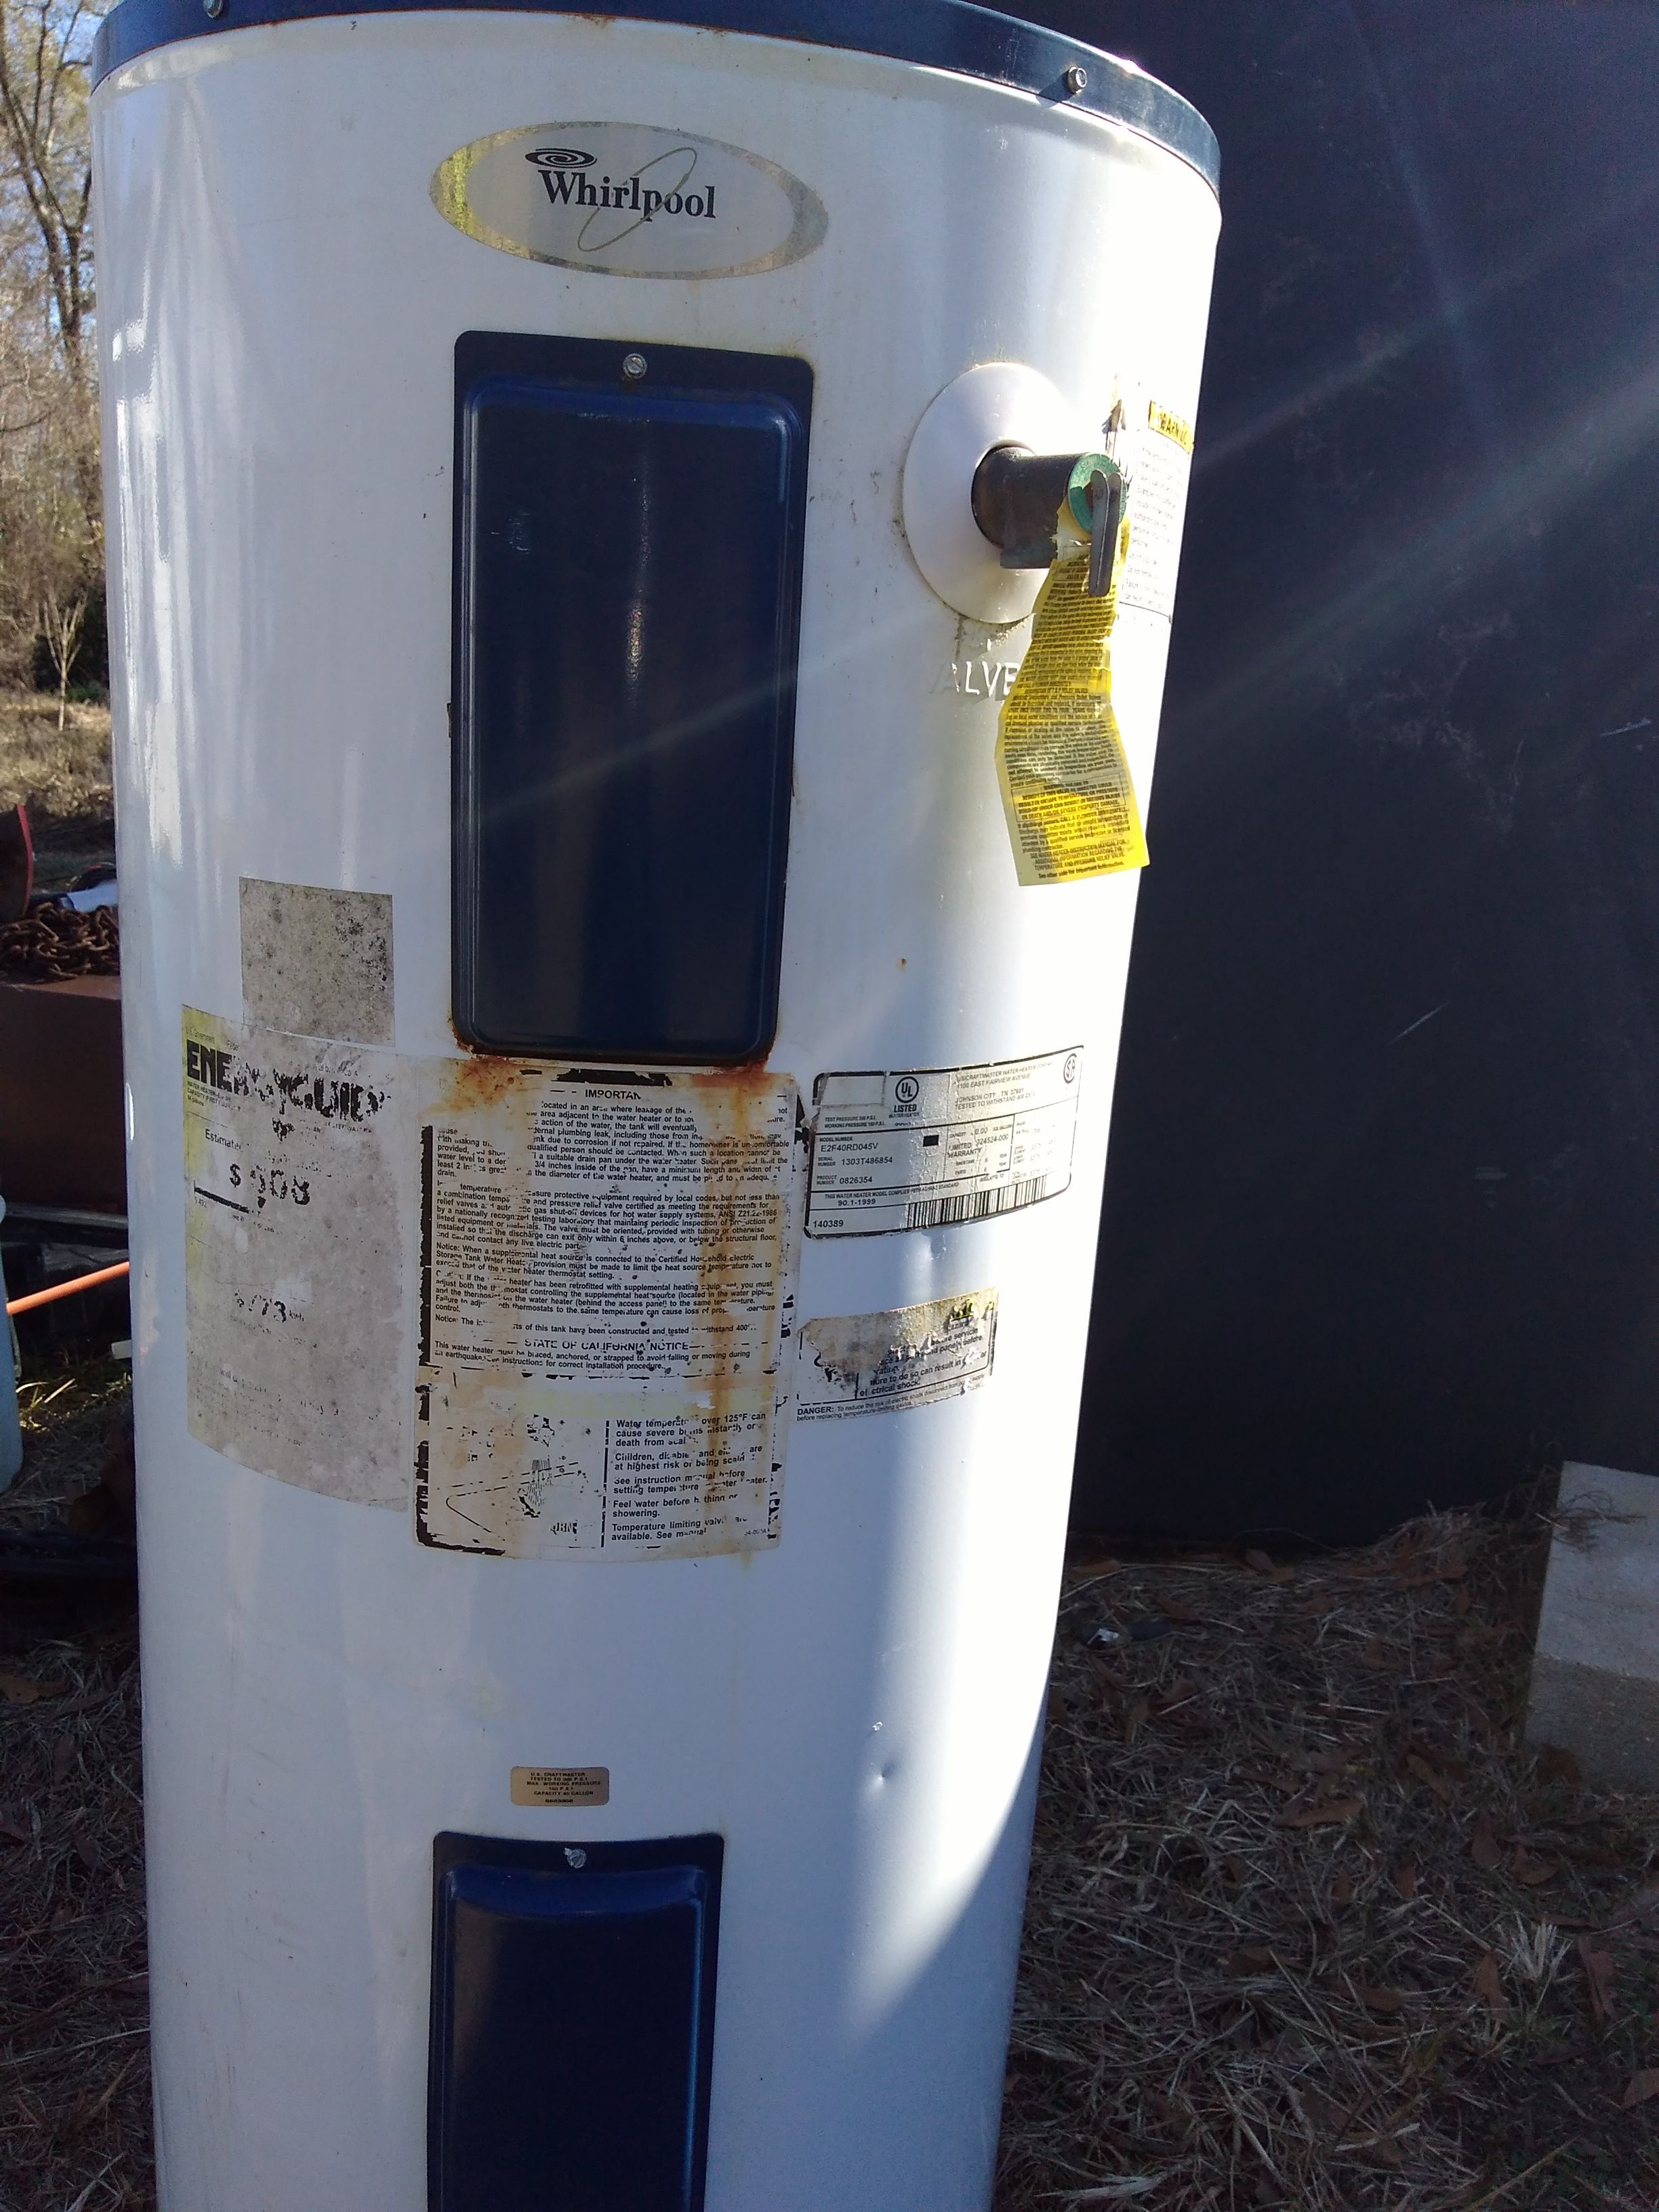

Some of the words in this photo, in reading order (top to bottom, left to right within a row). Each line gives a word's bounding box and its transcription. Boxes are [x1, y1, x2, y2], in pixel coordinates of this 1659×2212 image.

[537, 169, 716, 222] Whirlpool
[1012, 1073, 1030, 1081] AVENUE
[586, 1089, 641, 1099] IMPORTAN
[956, 1094, 982, 1103] JOHNSON
[894, 1104, 917, 1113] LISTED
[956, 1101, 976, 1110] TESTED
[559, 1111, 589, 1121] adjacent
[614, 1131, 647, 1141] including
[574, 1138, 608, 1146] corrosion
[560, 1147, 585, 1156] person
[821, 1143, 878, 1152] E2F40RD045V
[948, 1147, 982, 1158] WARRANTY
[577, 1155, 595, 1163] drain
[842, 1157, 893, 1165] 1303T486854
[535, 1160, 545, 1168] 3/4
[548, 1162, 571, 1170] inches
[575, 1163, 596, 1171] inside
[554, 1191, 589, 1200] protective
[632, 1194, 661, 1203] required
[696, 1194, 718, 1202] codes,
[838, 1198, 876, 1206] 90.1-1999
[712, 1202, 756, 1212] requirements
[455, 1208, 487, 1218] nationally
[813, 1220, 844, 1228] 140389
[478, 1236, 503, 1244] contact
[436, 1242, 459, 1251] Notice:
[463, 1245, 482, 1254] When
[466, 1254, 481, 1262] Tank
[533, 1261, 565, 1269] provision
[569, 1282, 603, 1290] retrofitted
[624, 1284, 670, 1292] supplemental
[674, 1284, 698, 1292] heating
[435, 1340, 449, 1349] This
[452, 1343, 470, 1352] water
[604, 1354, 634, 1364] strapped
[920, 1368, 933, 1376] can
[935, 1362, 954, 1372] result
[798, 1406, 834, 1415] DANGER:
[617, 1420, 642, 1429] Water
[702, 1417, 720, 1425] over
[752, 1412, 766, 1420] can
[617, 1429, 642, 1437] cause
[647, 1428, 675, 1437] severe
[616, 1438, 640, 1447] death
[644, 1437, 664, 1446] from
[628, 1461, 659, 1471] highest
[664, 1460, 679, 1469] risk
[634, 1475, 680, 1485] instruction
[613, 1500, 631, 1508] Feel
[636, 1499, 659, 1507] water
[663, 1496, 690, 1507] before
[613, 1509, 660, 1518] showering.
[670, 1519, 701, 1529] limiting
[612, 1532, 653, 1541] available.
[657, 1531, 672, 1539] See
